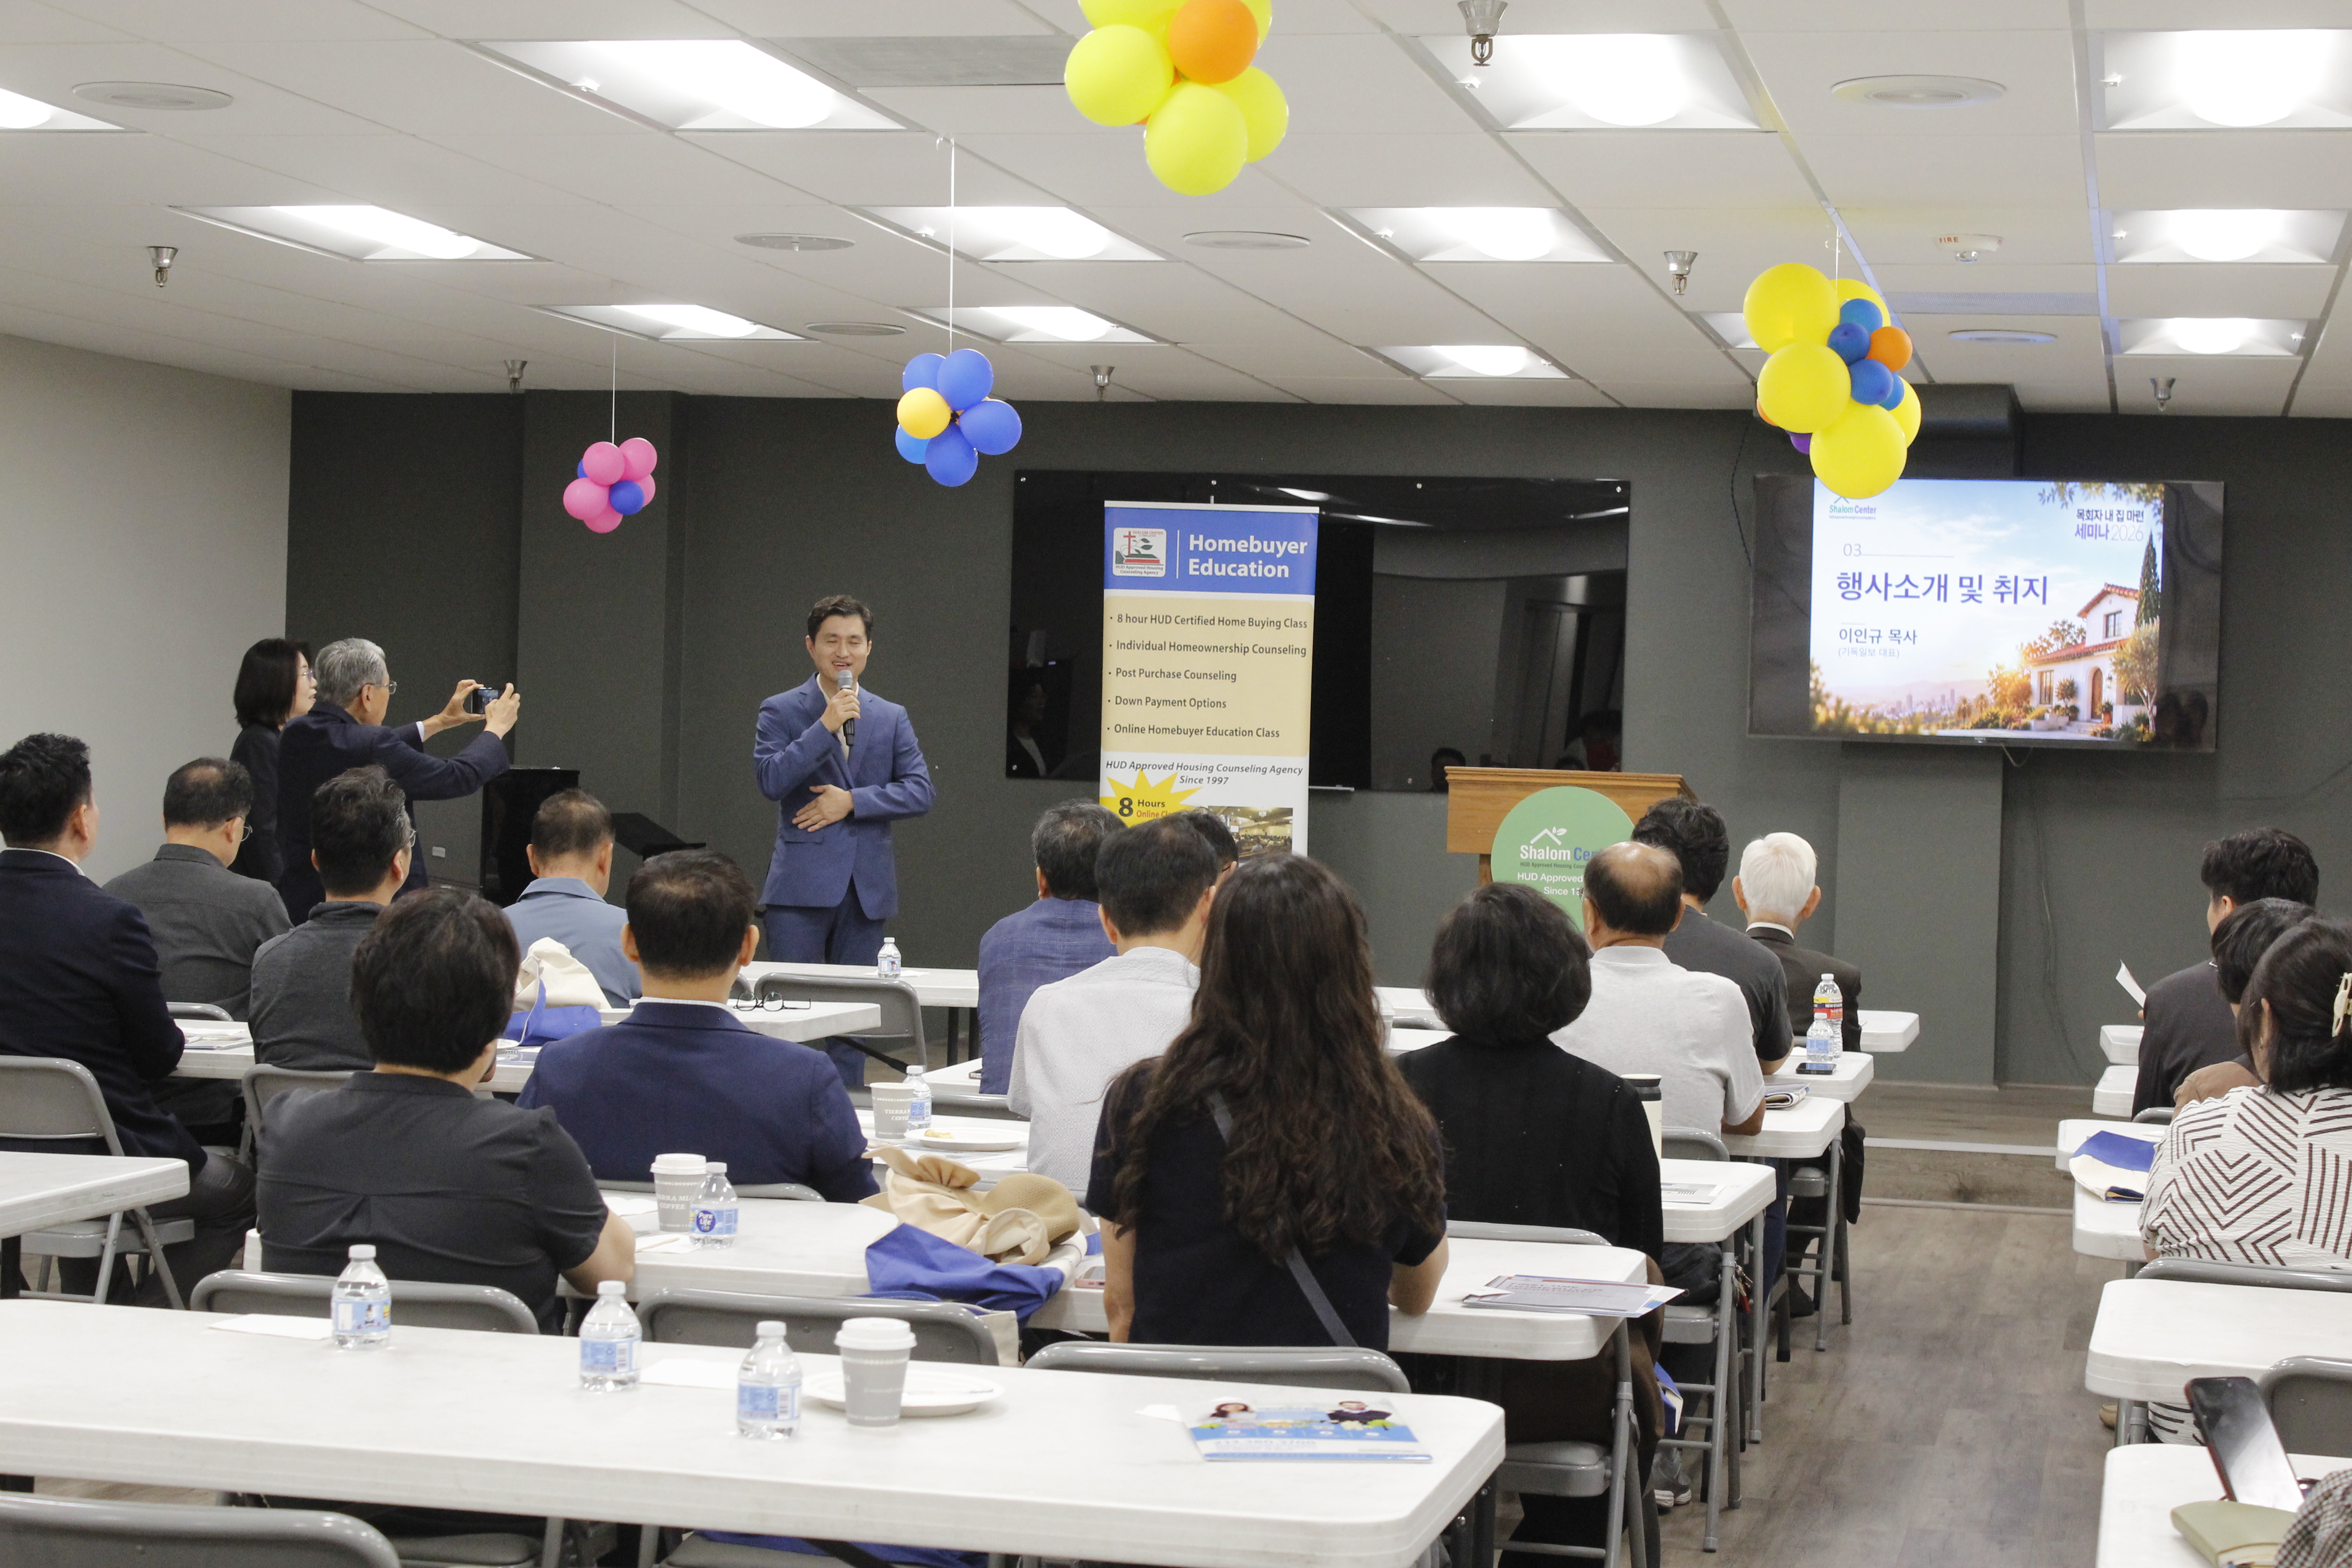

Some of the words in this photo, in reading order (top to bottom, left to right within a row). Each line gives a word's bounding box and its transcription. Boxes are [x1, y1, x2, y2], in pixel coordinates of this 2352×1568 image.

[1829, 505, 1853, 513] Shalom
[1854, 505, 1877, 514] Center
[2077, 509, 2103, 521] 목회자
[2105, 509, 2113, 522] 내
[2116, 510, 2124, 522] 집
[2127, 510, 2144, 523] 마련
[2075, 524, 2110, 540] 세미나
[2111, 524, 2144, 542] 2026
[1189, 534, 1308, 557] Homebuyer
[1843, 543, 1862, 557] 03
[1188, 559, 1289, 578] Education
[1837, 572, 1948, 603] 행사소개
[1959, 574, 1983, 604] 및
[1993, 574, 2048, 605] 취지
[1117, 614, 1123, 623] 8
[1125, 614, 1148, 624] hour
[1150, 615, 1171, 625] HUD
[1174, 615, 1215, 626] Certified
[1218, 617, 1246, 627] Home
[1248, 617, 1281, 629] Buying
[1284, 618, 1308, 628] Class
[1839, 627, 1883, 644] 이인규
[1888, 629, 1917, 645] 목사
[1117, 640, 1166, 652] Individual
[1169, 642, 1249, 655] Homeownership
[1252, 644, 1307, 657] Counseling
[1838, 647, 1876, 658] (기독일보
[1879, 648, 1900, 659] 대표)
[1116, 668, 1136, 678] Post
[1138, 669, 1181, 679] Purchase
[1184, 670, 1237, 682] Counseling
[1115, 696, 1142, 706] Down
[1145, 697, 1186, 709] Payment
[1189, 698, 1226, 710] Options
[1114, 724, 1146, 734] Online
[1148, 725, 1204, 736] Homebuyer
[1206, 726, 1254, 737] Education
[1256, 728, 1280, 738] Class
[1106, 760, 1127, 769] HUD
[1129, 761, 1174, 772] Approved
[1176, 763, 1214, 773] Housing
[1216, 764, 1267, 775] Counseling
[1269, 766, 1303, 775] Agency
[1180, 775, 1204, 784] Since
[1206, 776, 1229, 785] 1997
[1119, 797, 1133, 817] 8
[1137, 810, 1159, 818] Online
[1520, 845, 1571, 861] Shalom
[1518, 872, 1538, 881] HUD
[1540, 873, 1583, 883] Approved
[1544, 887, 1568, 895] Since
[698, 1211, 714, 1220] Pure
[700, 1218, 713, 1226] Life
